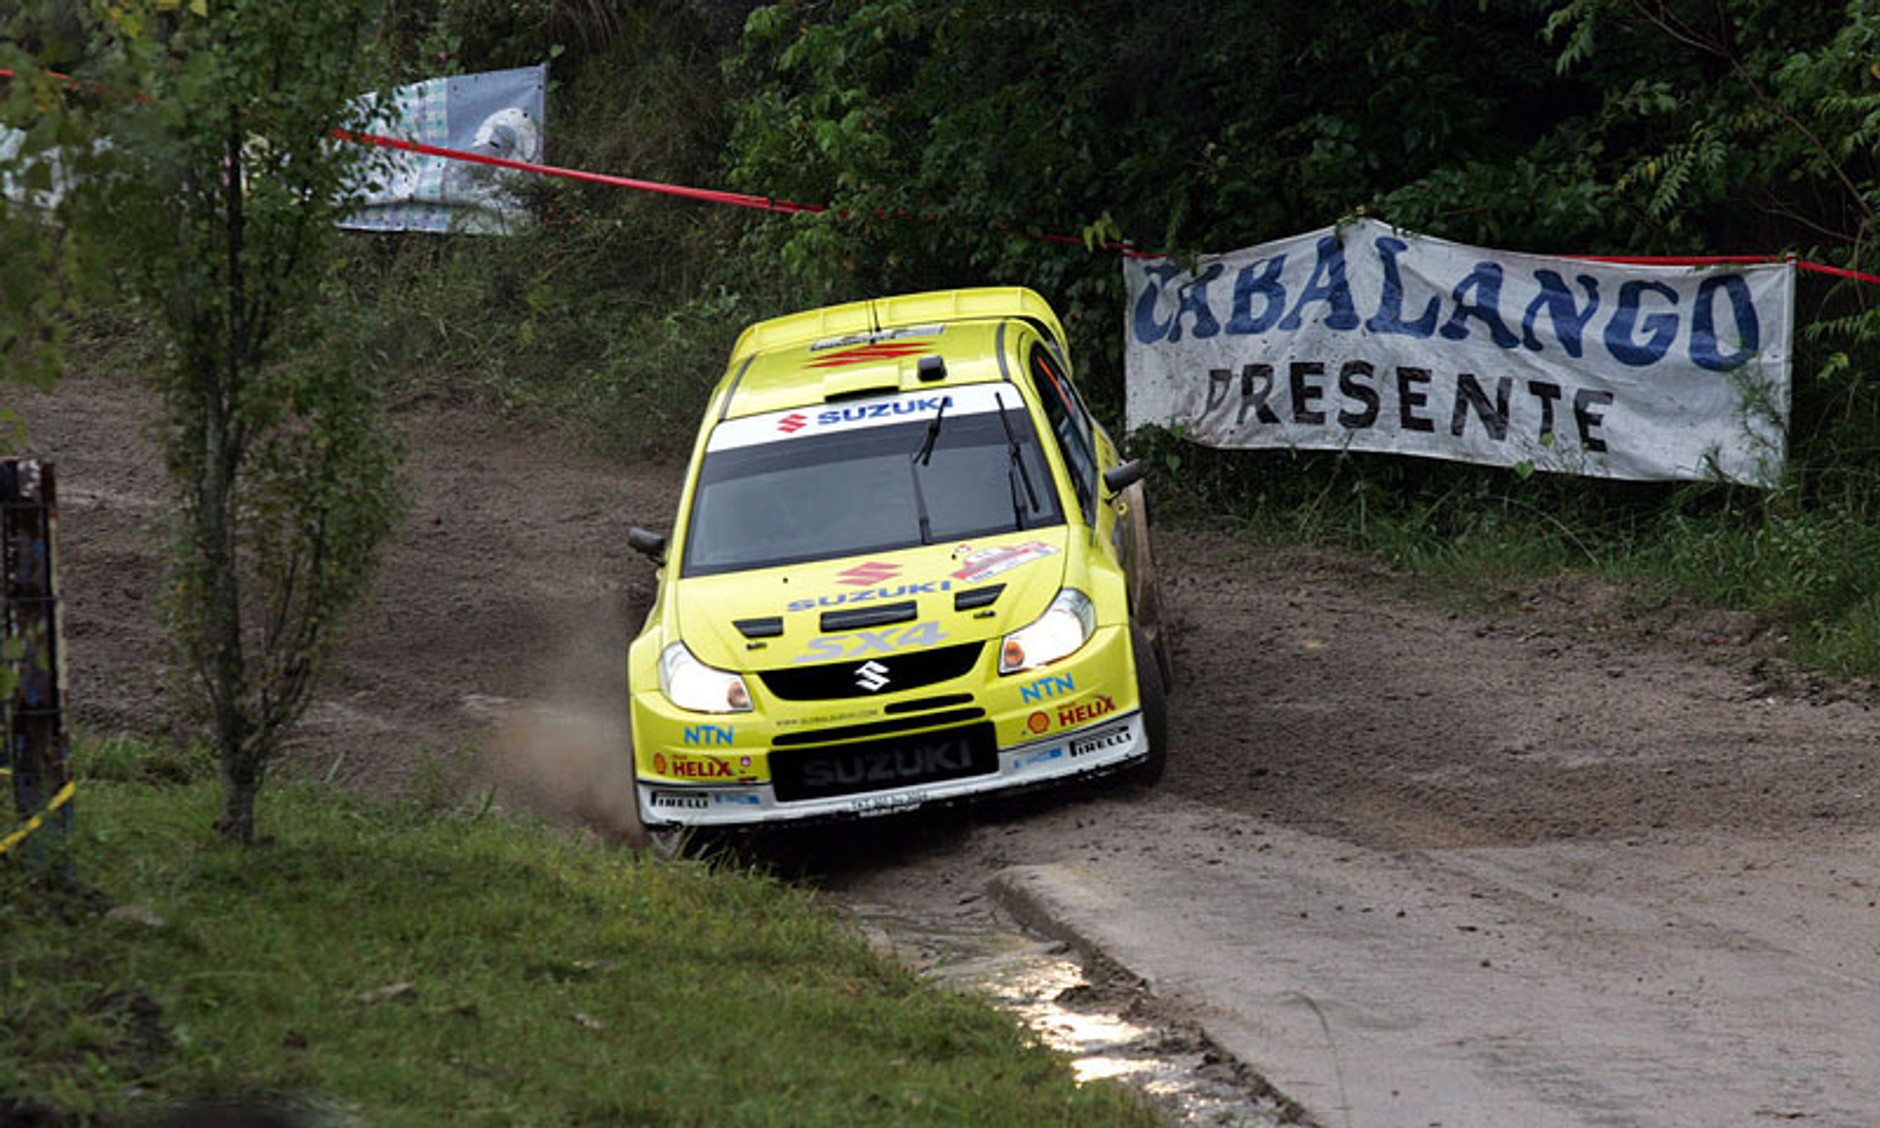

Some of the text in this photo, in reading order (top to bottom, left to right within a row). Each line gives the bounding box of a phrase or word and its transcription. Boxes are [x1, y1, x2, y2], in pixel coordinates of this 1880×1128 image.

[1134, 236, 1760, 373] CABALANGO
[817, 396, 953, 425] SUZUKI
[1196, 360, 1615, 453] PRESENTE
[787, 580, 951, 612] SUZUKI
[790, 621, 949, 663] SX4
[1020, 672, 1075, 704] NTN
[1058, 694, 1116, 726] HELIX
[684, 724, 734, 746] NTN
[1068, 725, 1132, 758] PIRELLI
[672, 755, 735, 777] HELIX
[803, 738, 973, 787] SUZUKI
[650, 790, 709, 809] PIRELLI
